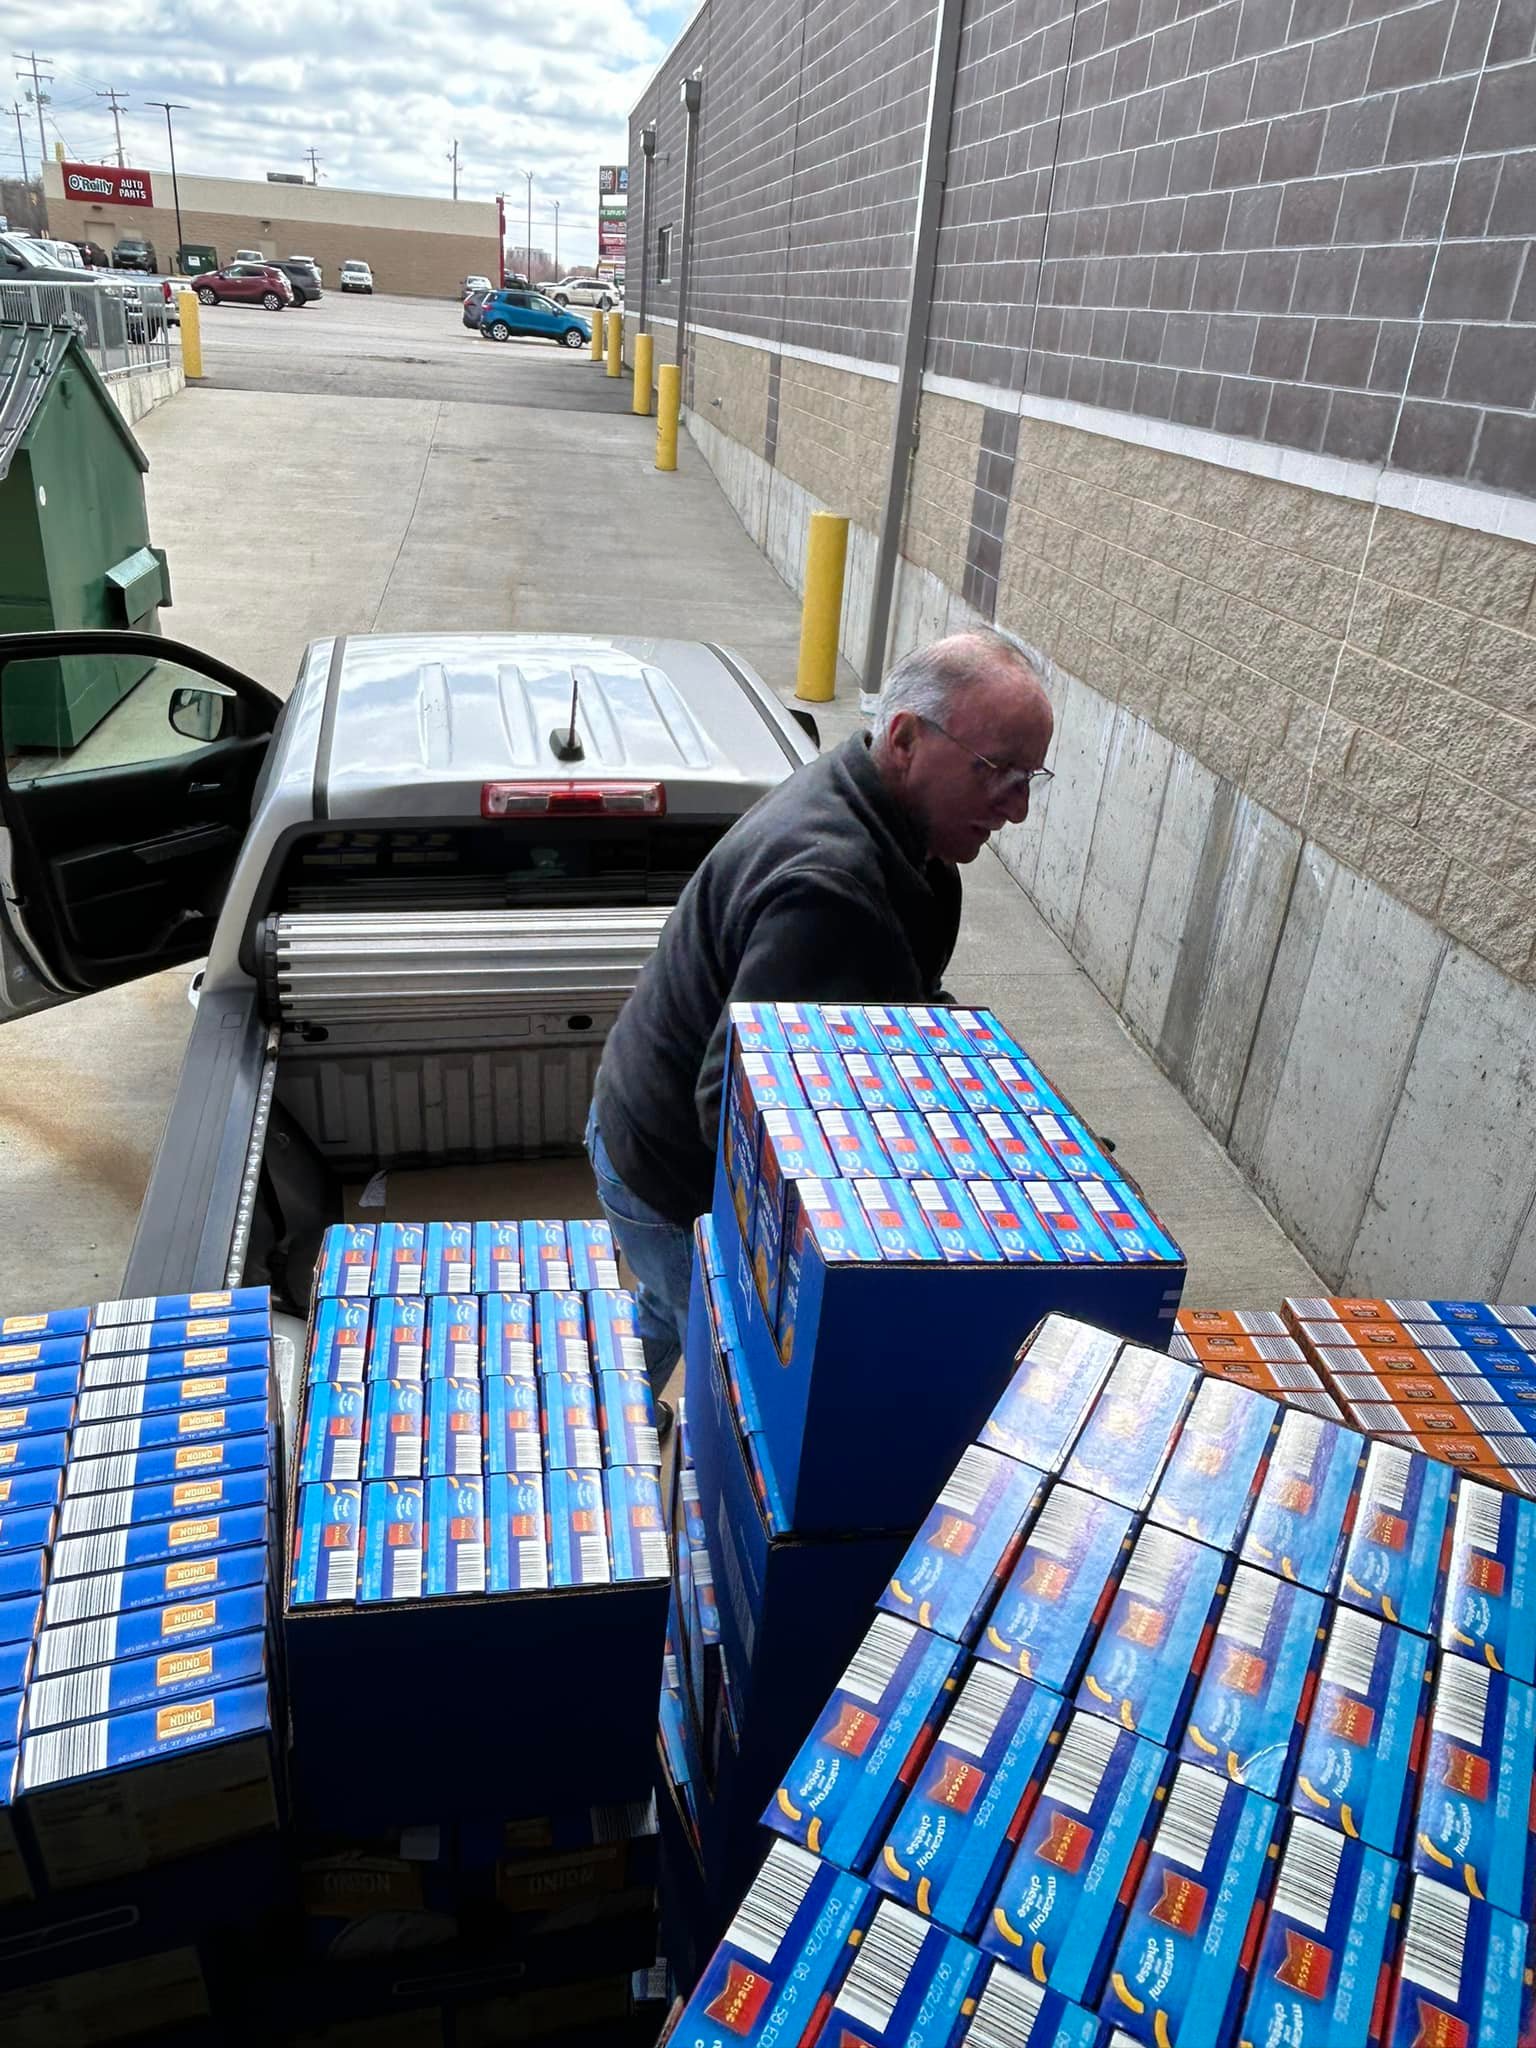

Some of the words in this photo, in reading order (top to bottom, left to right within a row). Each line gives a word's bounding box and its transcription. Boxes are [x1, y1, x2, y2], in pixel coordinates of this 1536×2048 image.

[69, 175, 114, 195] O'Reilly
[119, 188, 147, 199] PARTS
[121, 179, 143, 189] AUTO
[173, 1608, 204, 1625] ONION
[168, 1657, 200, 1674] ONION
[168, 1708, 202, 1728] ONION
[841, 1711, 865, 1747] cheese
[799, 1758, 825, 1796] cheese
[809, 1759, 839, 1811] macaroni
[946, 1765, 969, 1802] cheese
[906, 1814, 931, 1855] cheese
[1055, 1822, 1076, 1862] cheese
[1440, 1802, 1454, 1842] cheese
[1454, 1803, 1471, 1857] macaroni
[917, 1816, 946, 1870] macaroni
[1017, 1875, 1041, 1917] cheese
[1029, 1876, 1056, 1933] macaroni
[1171, 1880, 1190, 1923] cheese
[805, 1898, 842, 1956] 09/02/26
[1136, 1938, 1159, 1983] cheese
[1150, 1938, 1174, 2000] macaroni
[726, 1974, 755, 2022] cheese
[917, 1962, 951, 2025] 09/02/26
